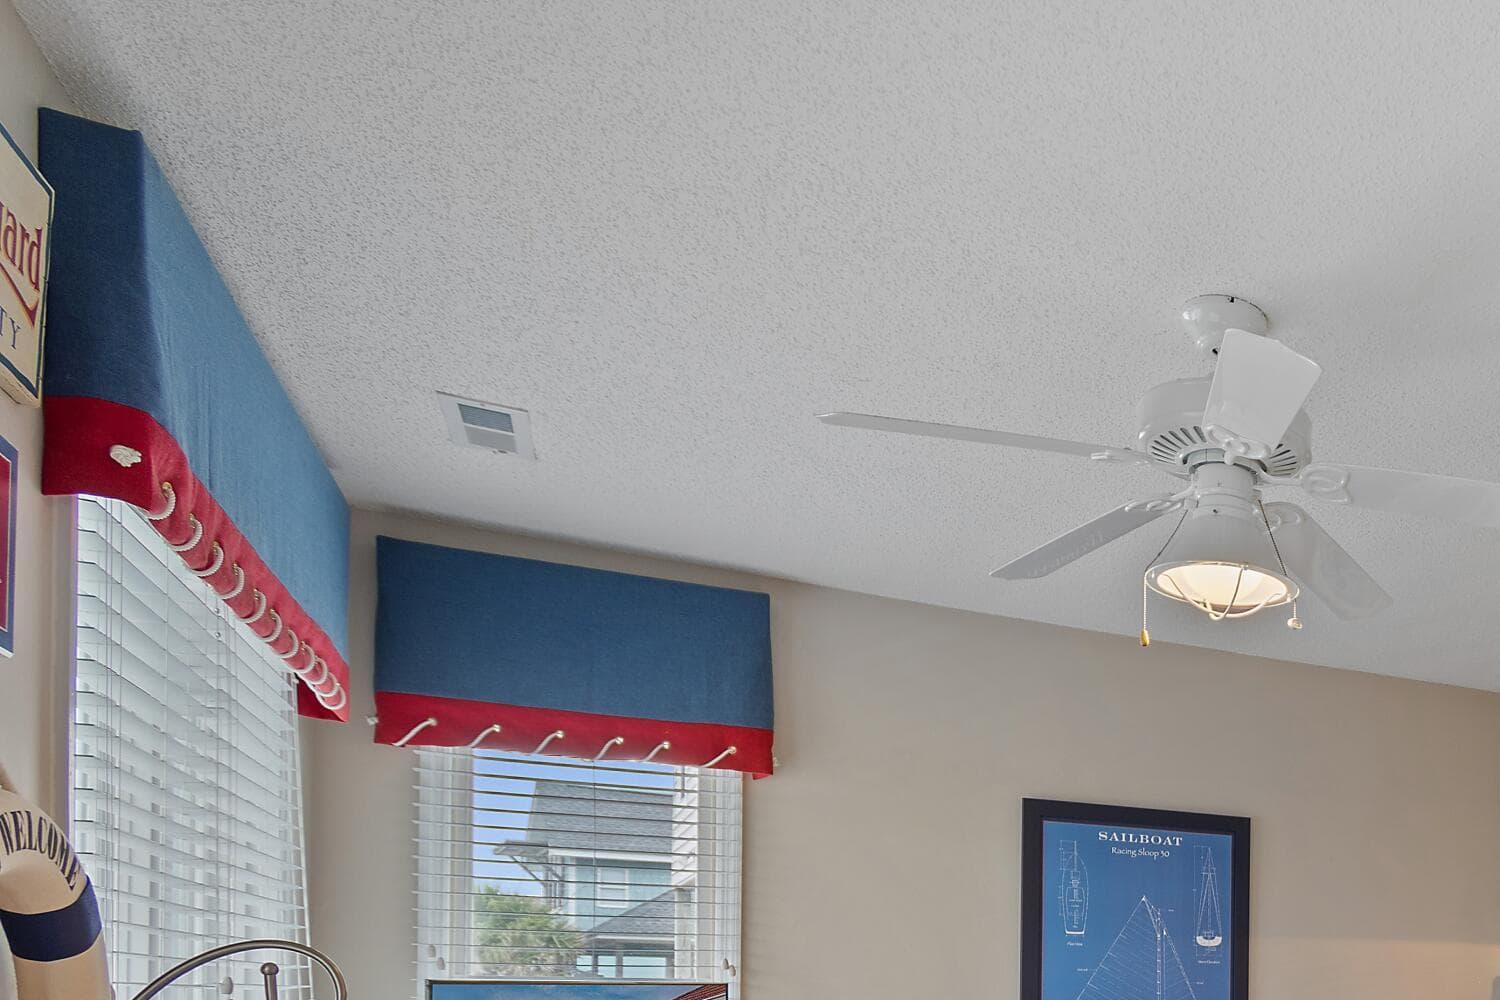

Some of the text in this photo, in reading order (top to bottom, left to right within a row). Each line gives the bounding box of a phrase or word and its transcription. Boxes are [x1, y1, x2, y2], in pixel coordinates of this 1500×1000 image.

[1097, 831, 1183, 847] SAILBOAT
[0, 810, 81, 891] WELCOME
[1111, 847, 1137, 858] Racing
[1138, 847, 1159, 861] Sloop
